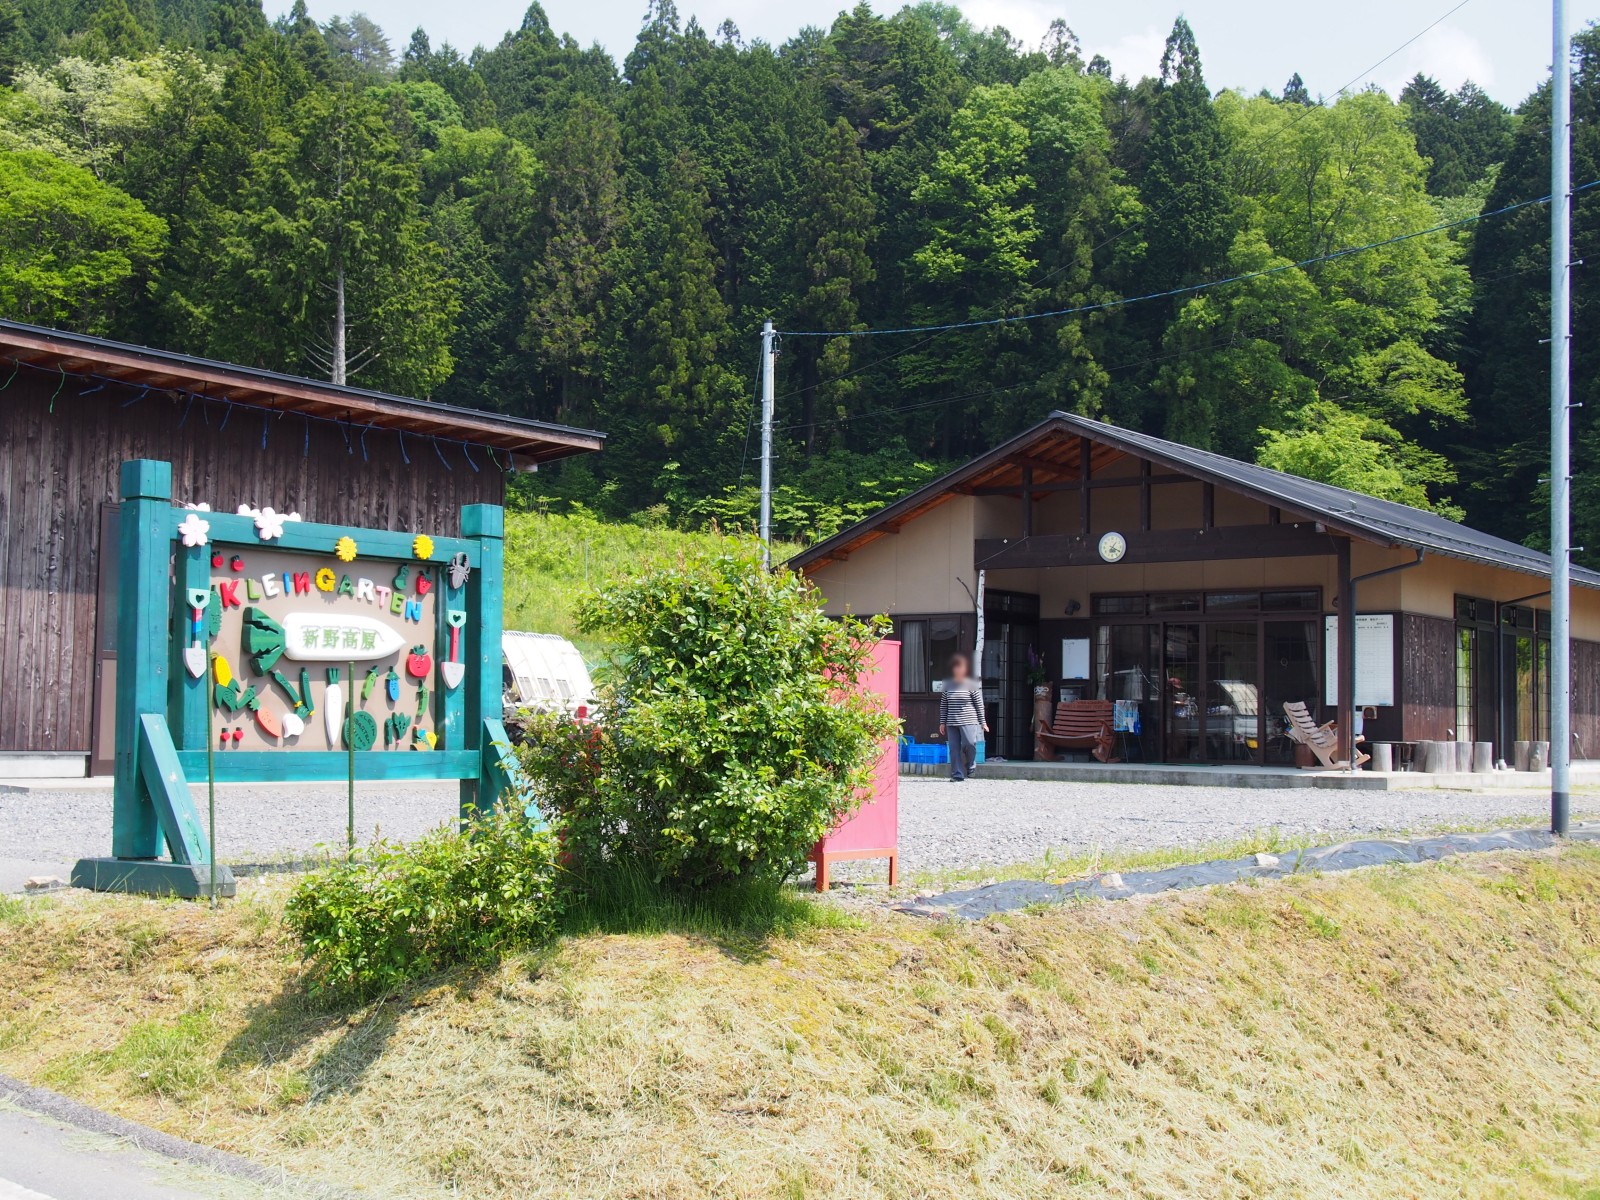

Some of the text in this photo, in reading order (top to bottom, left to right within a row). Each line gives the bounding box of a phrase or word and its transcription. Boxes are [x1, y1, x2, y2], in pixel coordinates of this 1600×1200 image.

[220, 567, 422, 622] KLEINGARTEN
[302, 628, 377, 651] 新野高原
